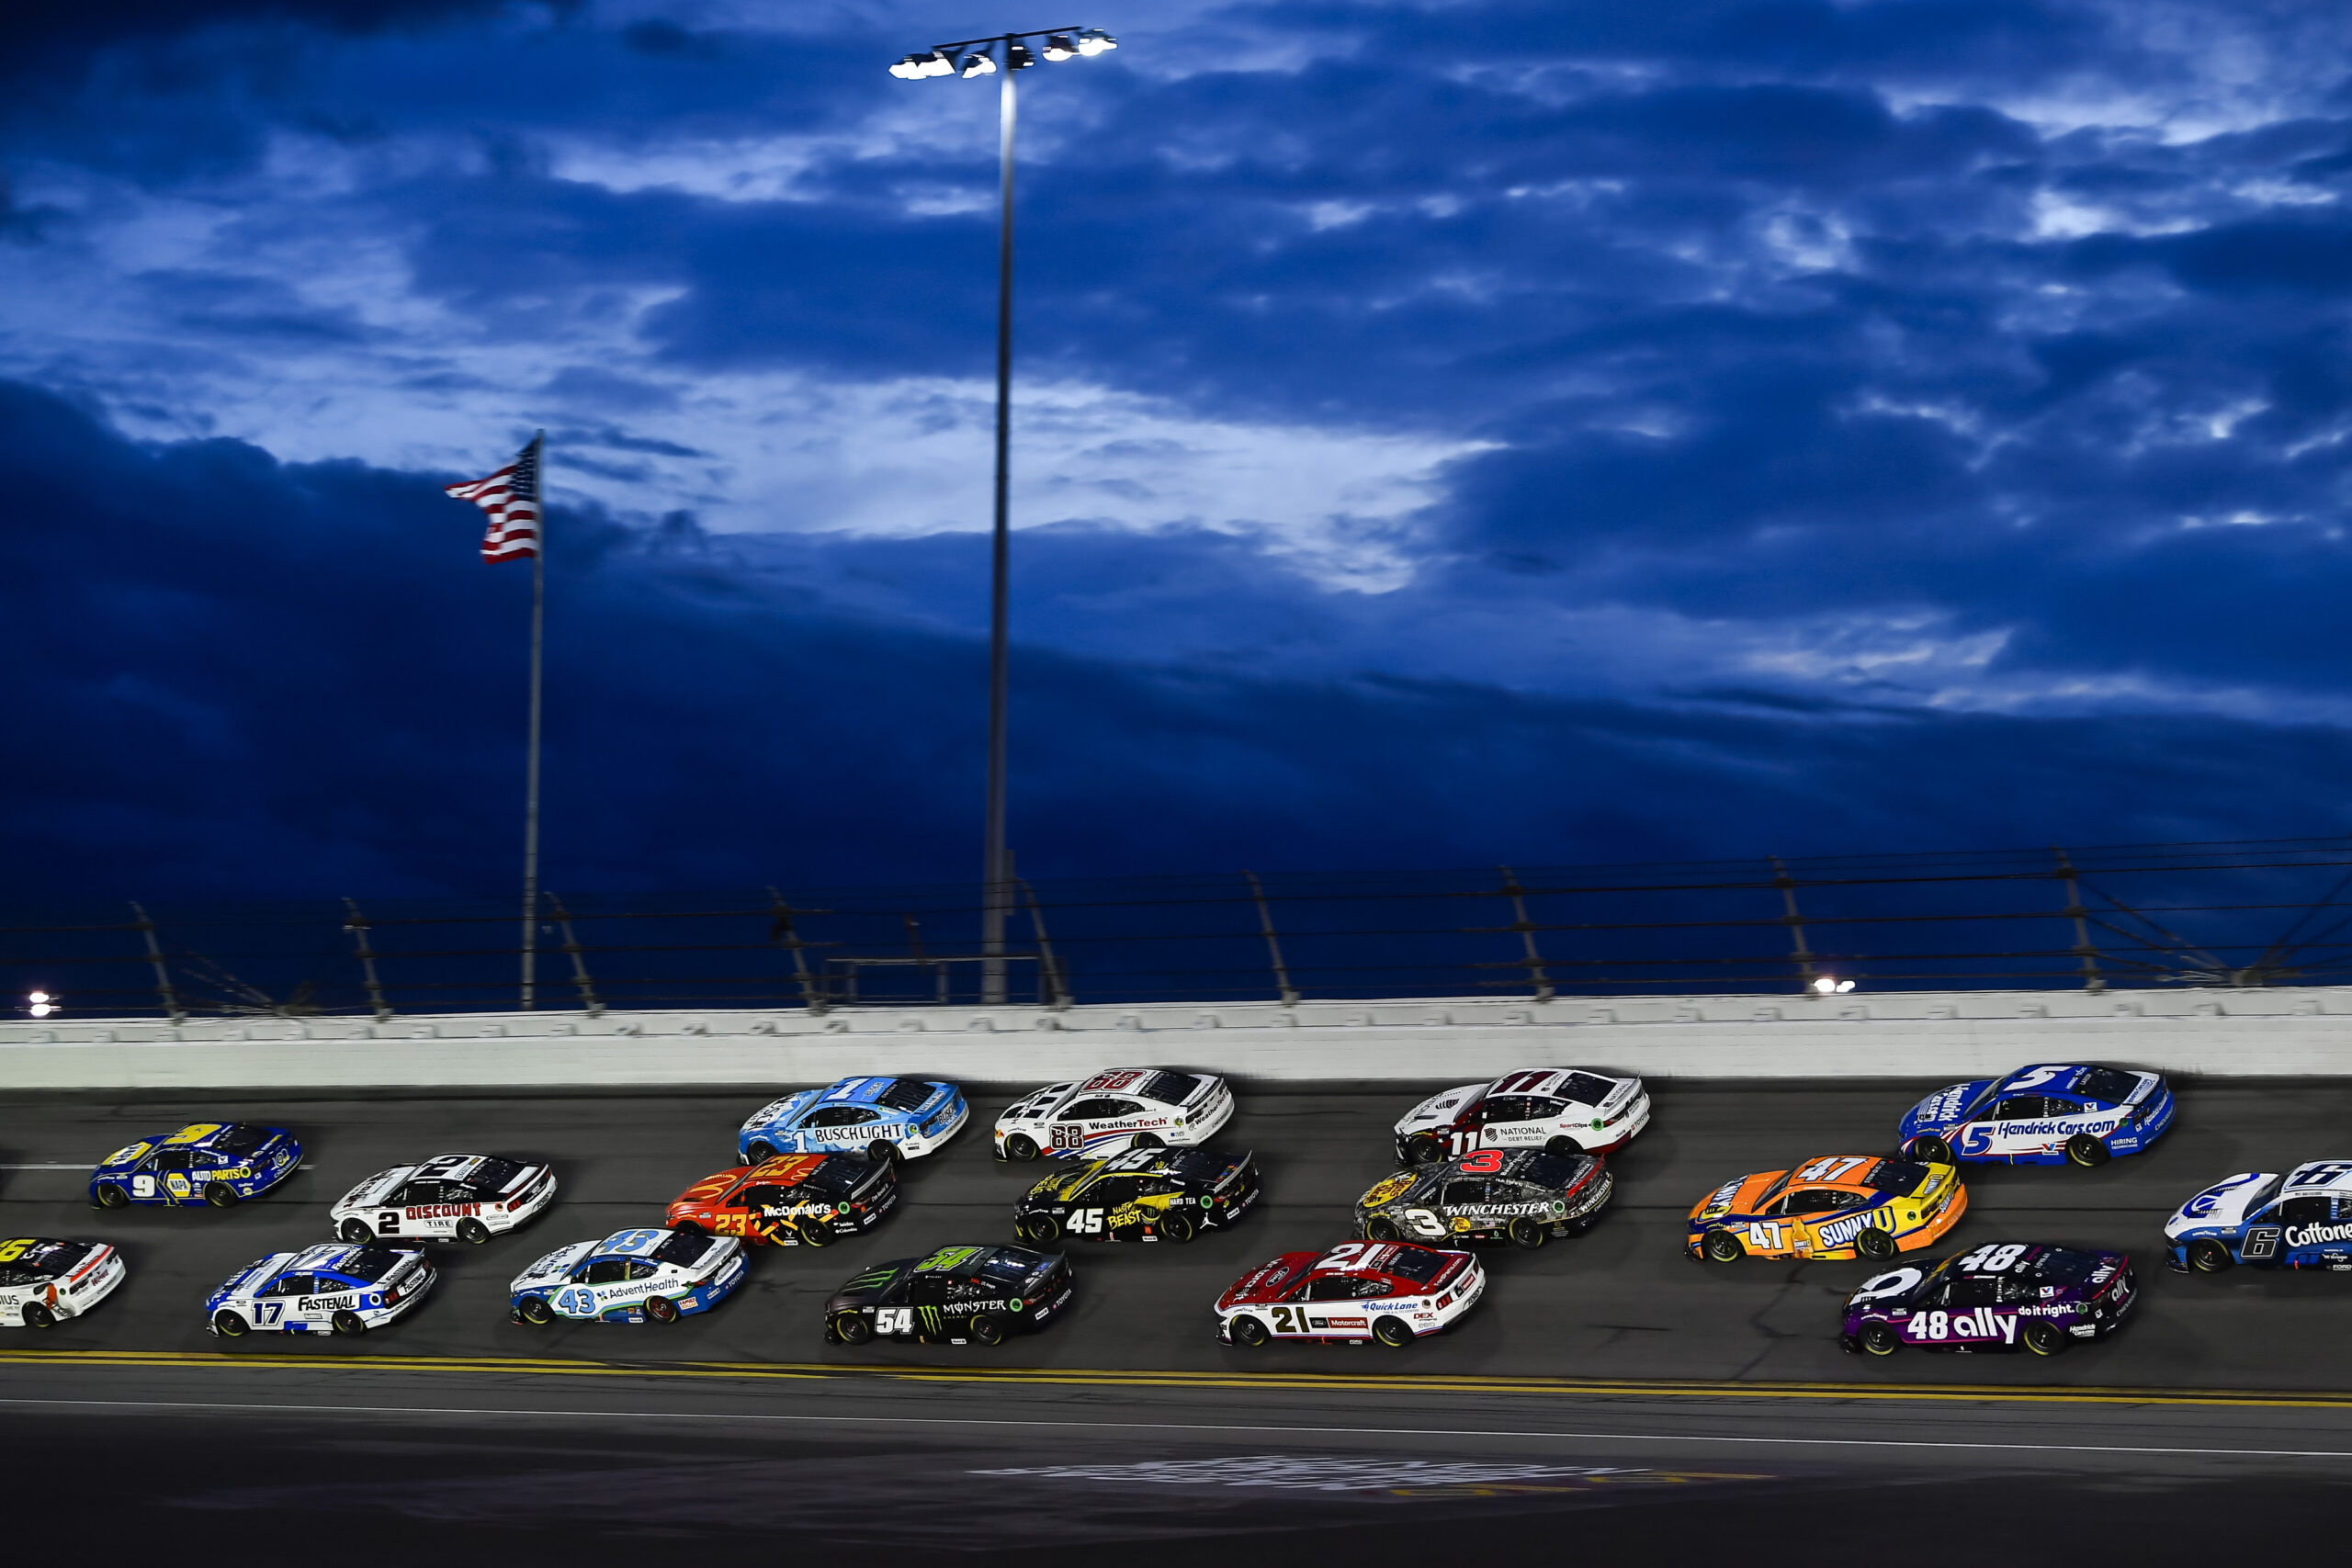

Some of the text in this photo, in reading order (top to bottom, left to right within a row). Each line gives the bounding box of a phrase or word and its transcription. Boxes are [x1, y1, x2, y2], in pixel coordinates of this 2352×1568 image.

[1194, 1093, 1227, 1125] WeatherTech
[1634, 1111, 1648, 1128] TOYOTA
[1089, 1117, 1167, 1130] WeatherTech
[1500, 1127, 1546, 1135] NATIONAL
[793, 1130, 808, 1154] 1
[1050, 1124, 1084, 1149] 88
[1451, 1132, 1478, 1155] 11
[1962, 1126, 1996, 1156] 5
[2111, 1136, 2137, 1146] HIRING
[1459, 1149, 1504, 1173] 3
[1796, 1157, 1868, 1181] 47
[169, 1179, 189, 1190] NAPA
[192, 1168, 241, 1181] AUTO PARTS
[132, 1175, 155, 1198] 9
[1245, 1188, 1260, 1205] TOYOTA
[1578, 1179, 1611, 1213] WINCHESTER
[405, 1202, 481, 1220] DISCOUNT
[763, 1202, 831, 1217] McDonald's
[1170, 1197, 1196, 1206] HARD TEA
[1442, 1201, 1550, 1216] WINCHESTER
[379, 1212, 401, 1235] 2
[715, 1213, 747, 1236] 23
[1066, 1208, 1104, 1234] 45
[1106, 1209, 1142, 1231] BEAST
[1404, 1209, 1447, 1236] 3
[1748, 1221, 1783, 1249] 47
[2240, 1227, 2282, 1259] 6
[1314, 1243, 1387, 1270] 21
[1958, 1245, 2027, 1271] 48
[386, 1259, 414, 1281] FASTENAL
[728, 1269, 745, 1288] TOYOTA
[2091, 1264, 2117, 1284] ally
[609, 1277, 679, 1299] AdventHealth
[1056, 1288, 1072, 1307] TOYOTA
[2111, 1276, 2130, 1302] ally
[298, 1295, 356, 1311] FASTENAL
[559, 1289, 596, 1314] 43
[679, 1297, 696, 1306] FAMILY
[1370, 1301, 1419, 1312] Quick Lane
[2018, 1303, 2075, 1317] do it right.
[253, 1302, 285, 1325] 17
[876, 1307, 914, 1335] 54
[1272, 1307, 1310, 1333] 21
[1413, 1312, 1434, 1320] DEX
[1907, 1311, 1949, 1339] 48
[1953, 1307, 2018, 1345] ally
